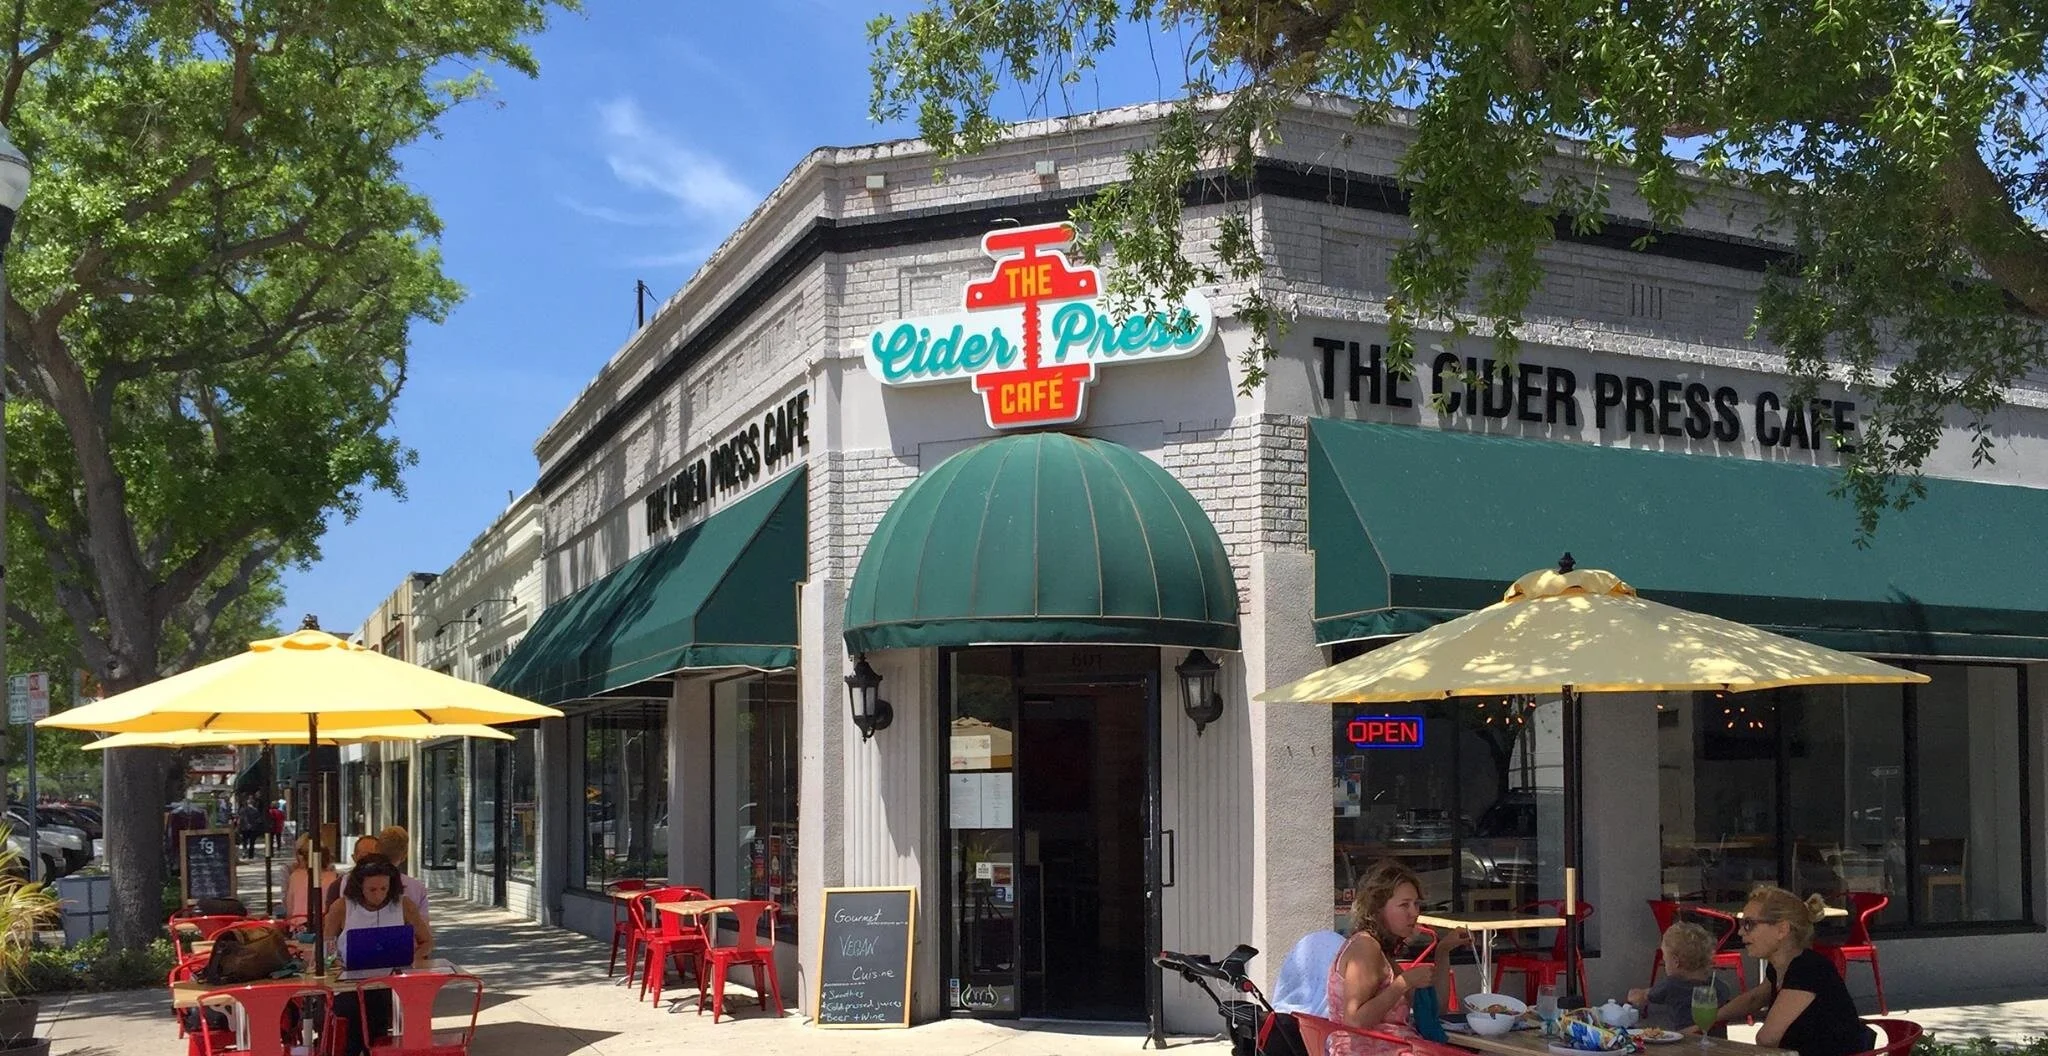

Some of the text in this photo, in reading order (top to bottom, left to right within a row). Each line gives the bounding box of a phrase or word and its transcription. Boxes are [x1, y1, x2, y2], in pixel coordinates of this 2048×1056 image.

[1005, 264, 1053, 299] THE
[872, 302, 1204, 382] Cider Press
[1000, 372, 1065, 415] CAFÉ
[1313, 337, 1857, 454] THE CIDER PRESS CAFE
[645, 389, 810, 536] THE CIDER PRESS CAFE
[1348, 721, 1418, 743] OPEN
[834, 907, 883, 924] Gourmet
[839, 935, 880, 957] VEGAN
[851, 966, 895, 981] Cuisine
